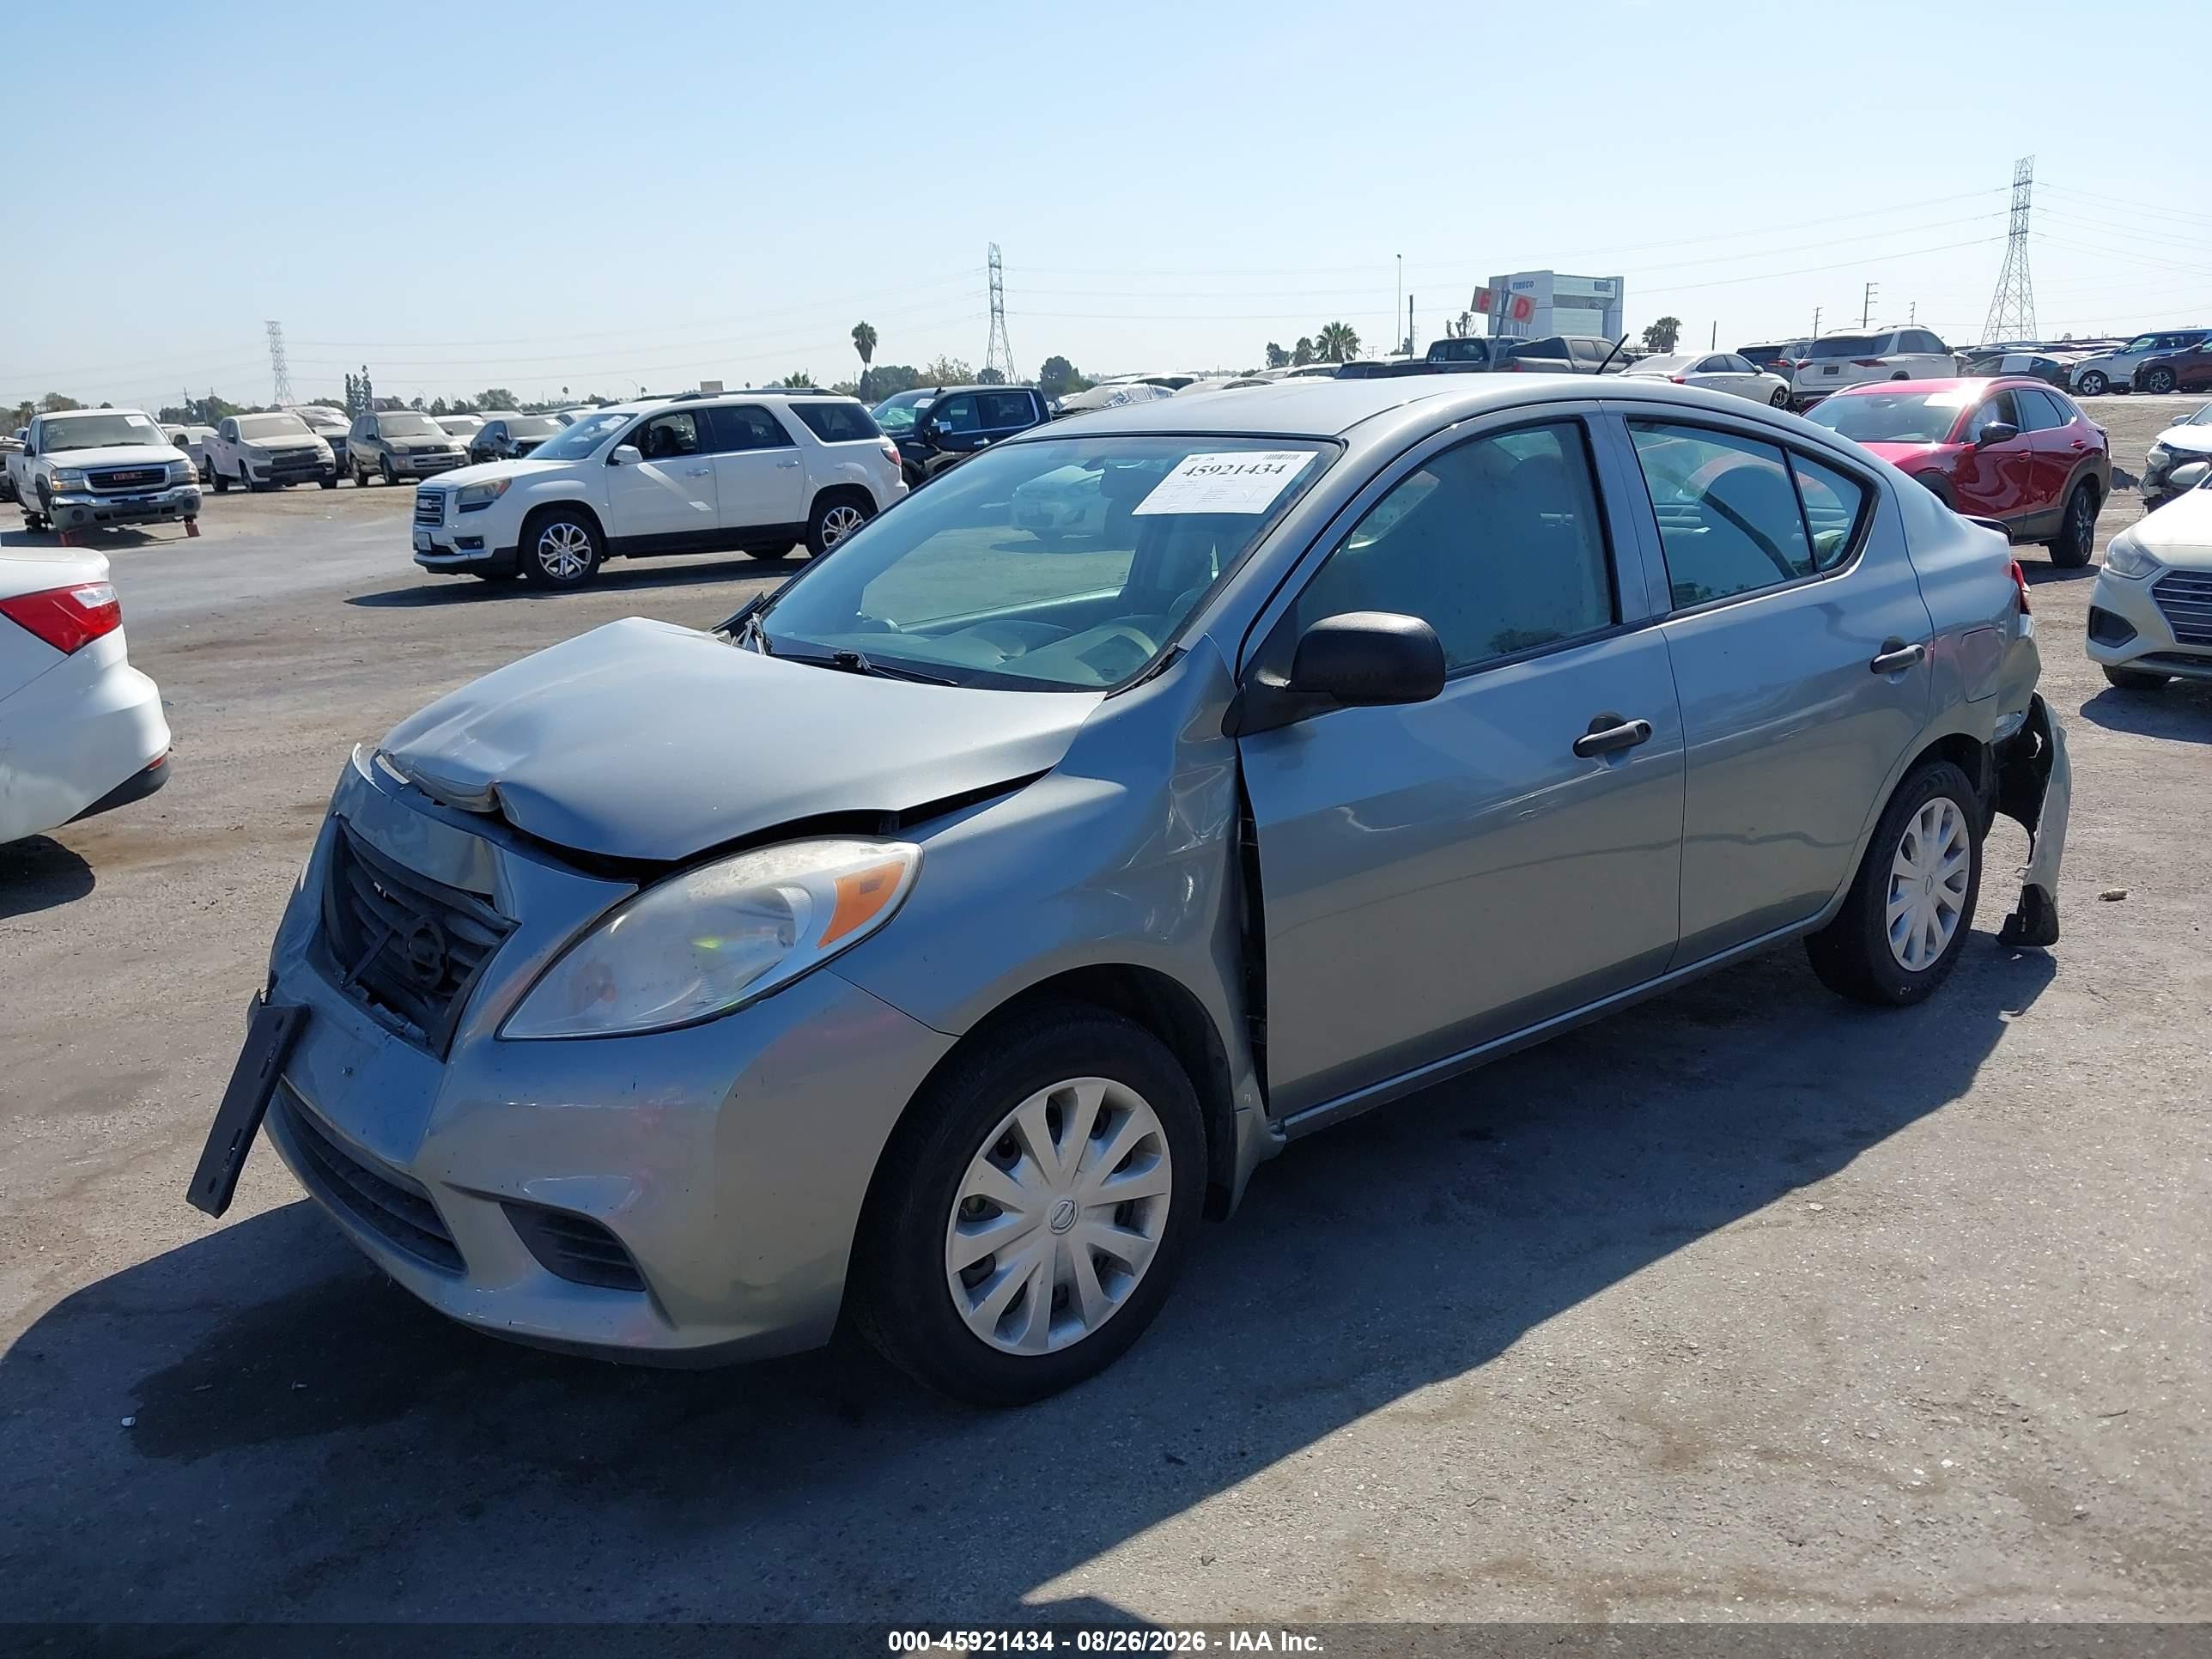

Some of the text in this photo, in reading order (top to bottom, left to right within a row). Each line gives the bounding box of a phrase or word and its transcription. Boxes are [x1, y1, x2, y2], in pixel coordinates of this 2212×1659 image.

[1480, 291, 1492, 311] E
[1514, 298, 1529, 319] D
[1182, 464, 1287, 477] 45921434
